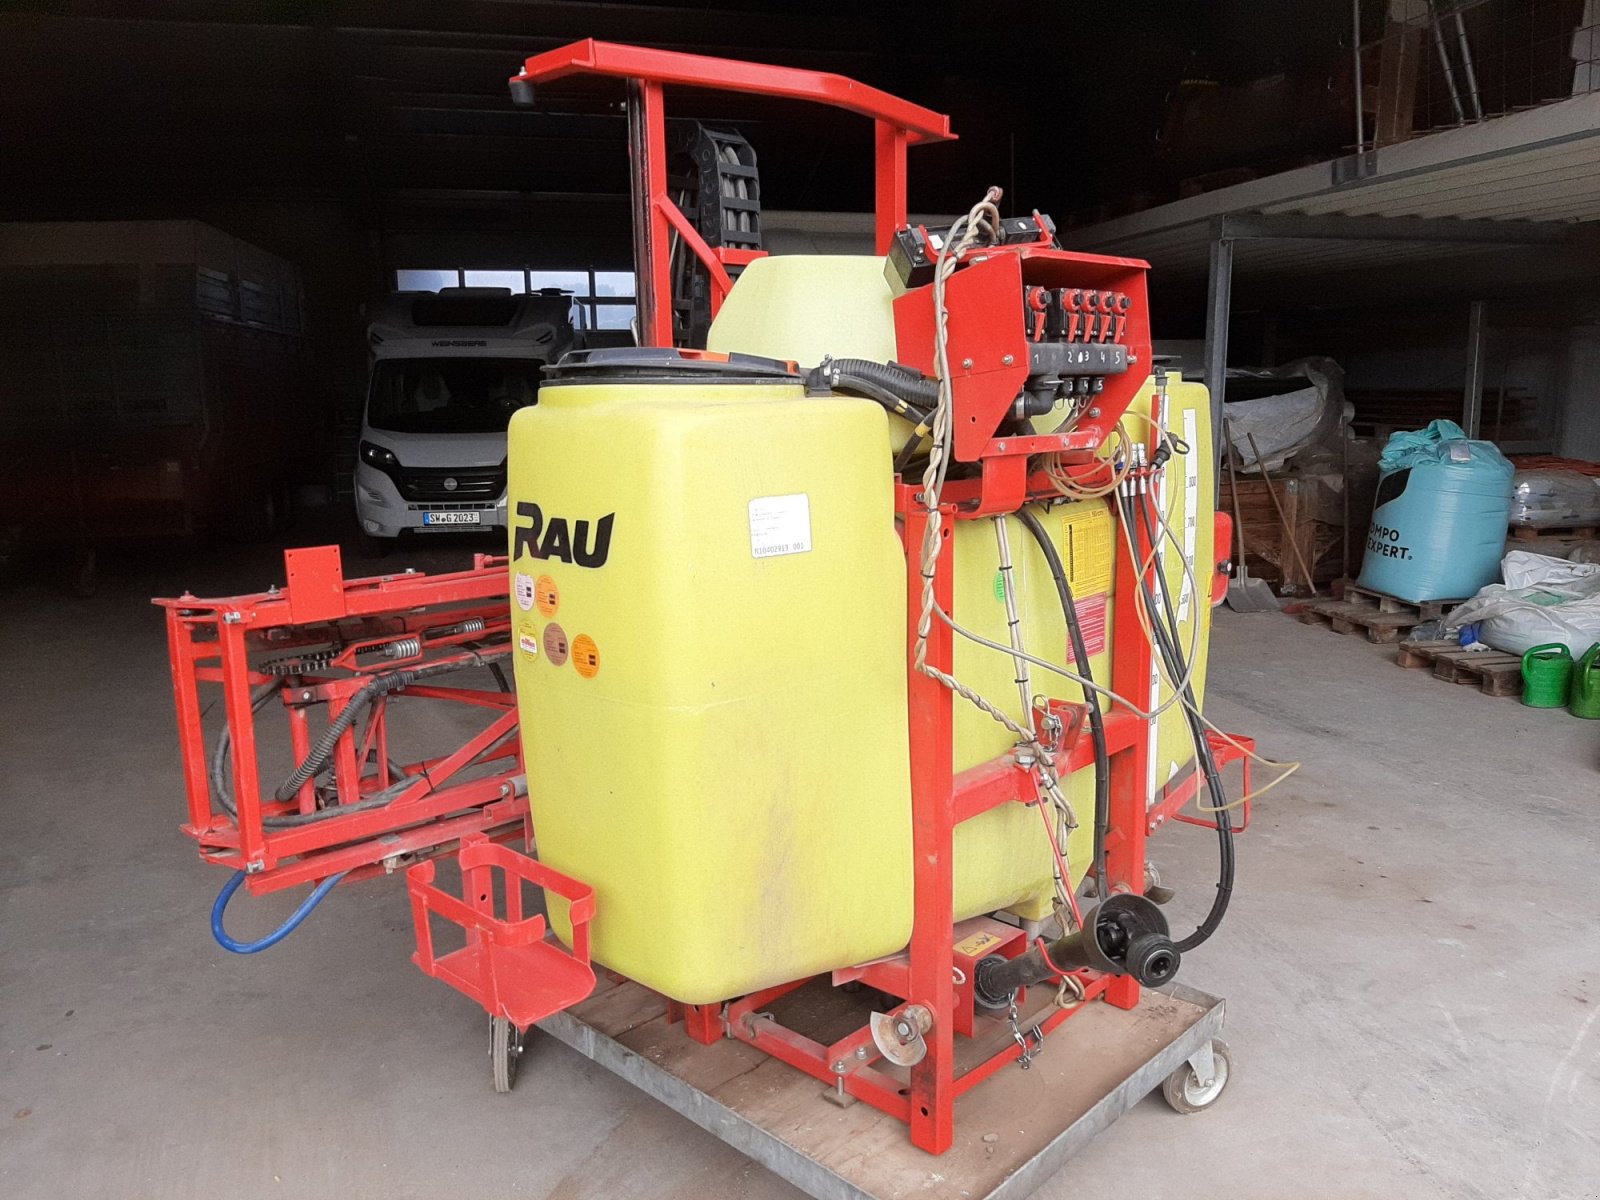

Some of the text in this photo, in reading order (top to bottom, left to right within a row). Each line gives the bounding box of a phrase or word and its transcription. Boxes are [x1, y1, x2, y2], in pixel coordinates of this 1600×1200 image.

[1034, 350, 1121, 364] 1 2 3 4 5
[1097, 380, 1104, 391] 5
[430, 513, 440, 523] SW
[453, 513, 474, 523] 2023
[513, 501, 616, 568] RAU
